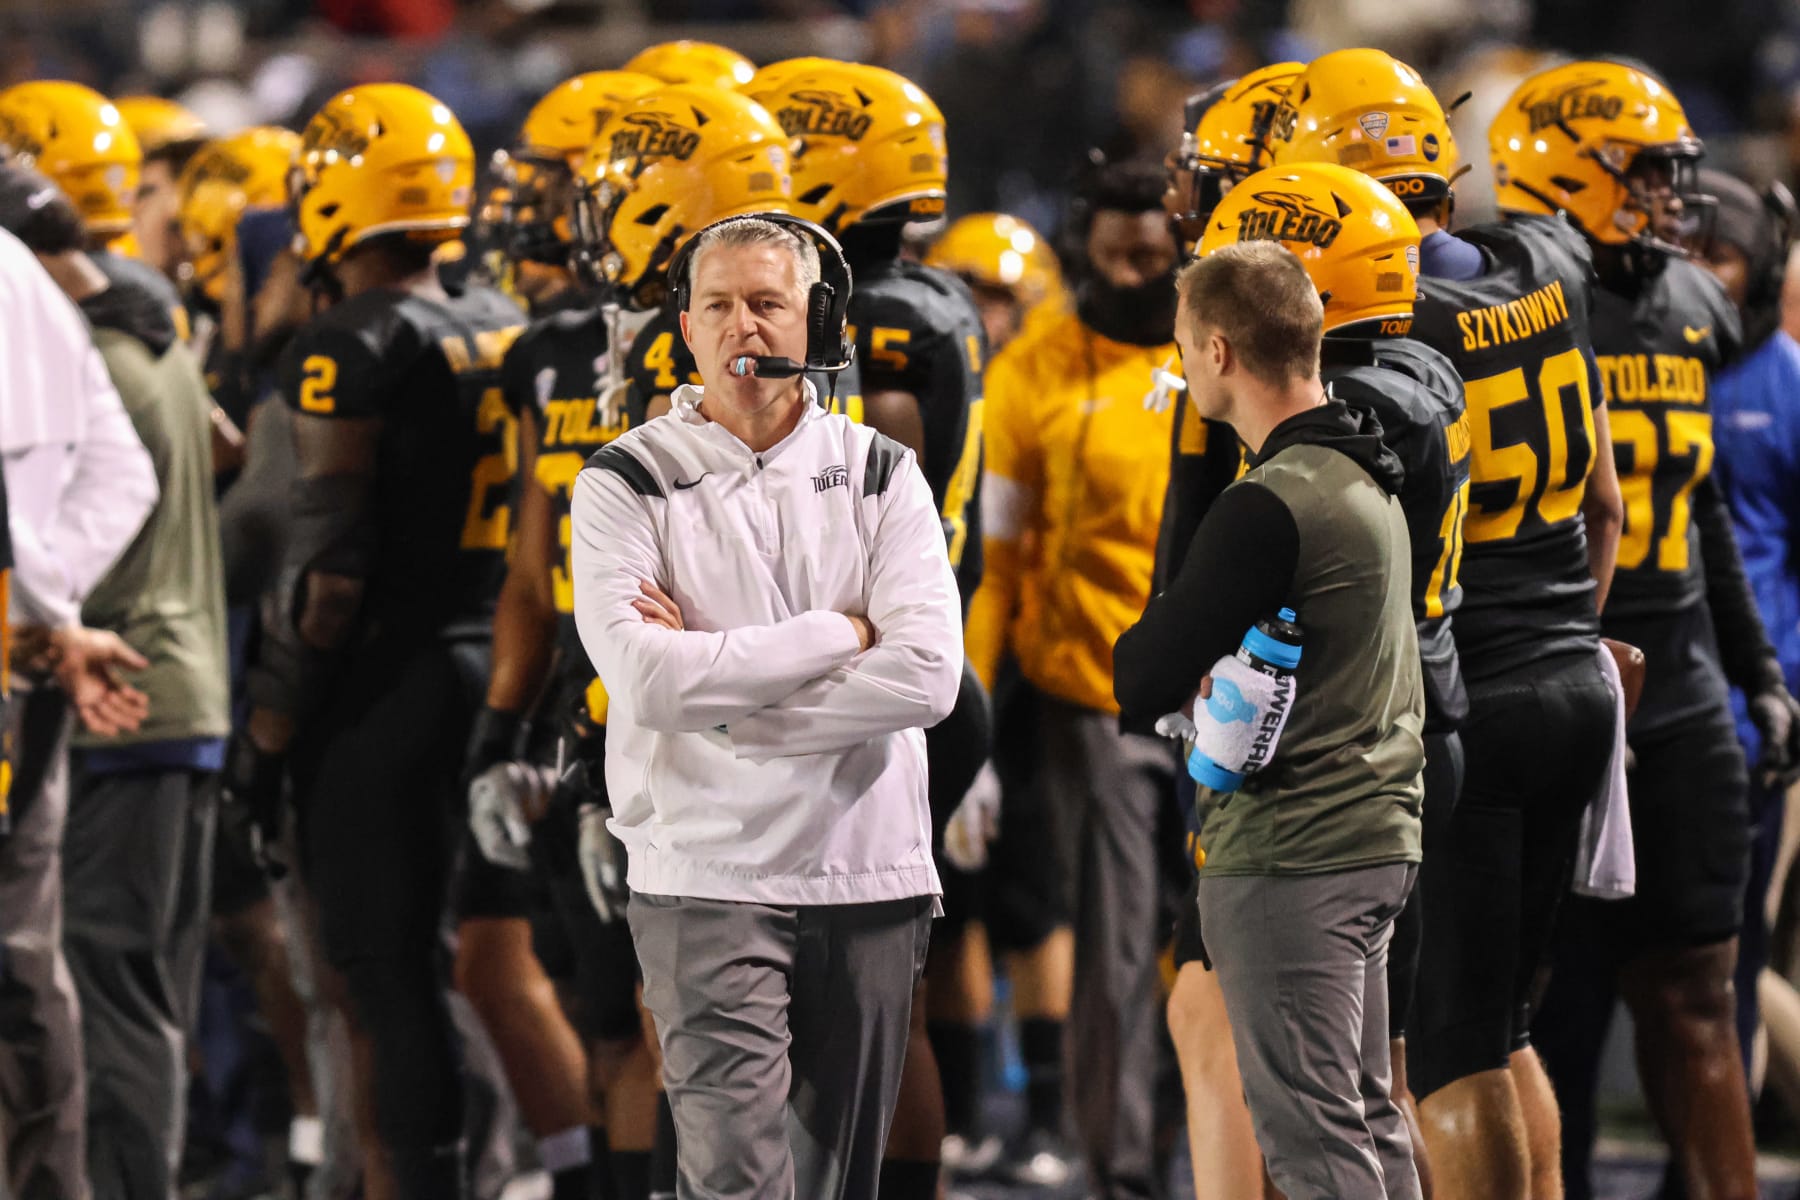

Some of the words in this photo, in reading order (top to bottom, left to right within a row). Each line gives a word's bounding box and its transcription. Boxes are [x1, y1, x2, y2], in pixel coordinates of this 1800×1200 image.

[1238, 207, 1343, 248] TOLEDO
[1456, 280, 1569, 352] SZYKOWNY
[300, 355, 337, 414] 2
[1596, 354, 1706, 403] TOLEDO
[1463, 347, 1597, 544] 50
